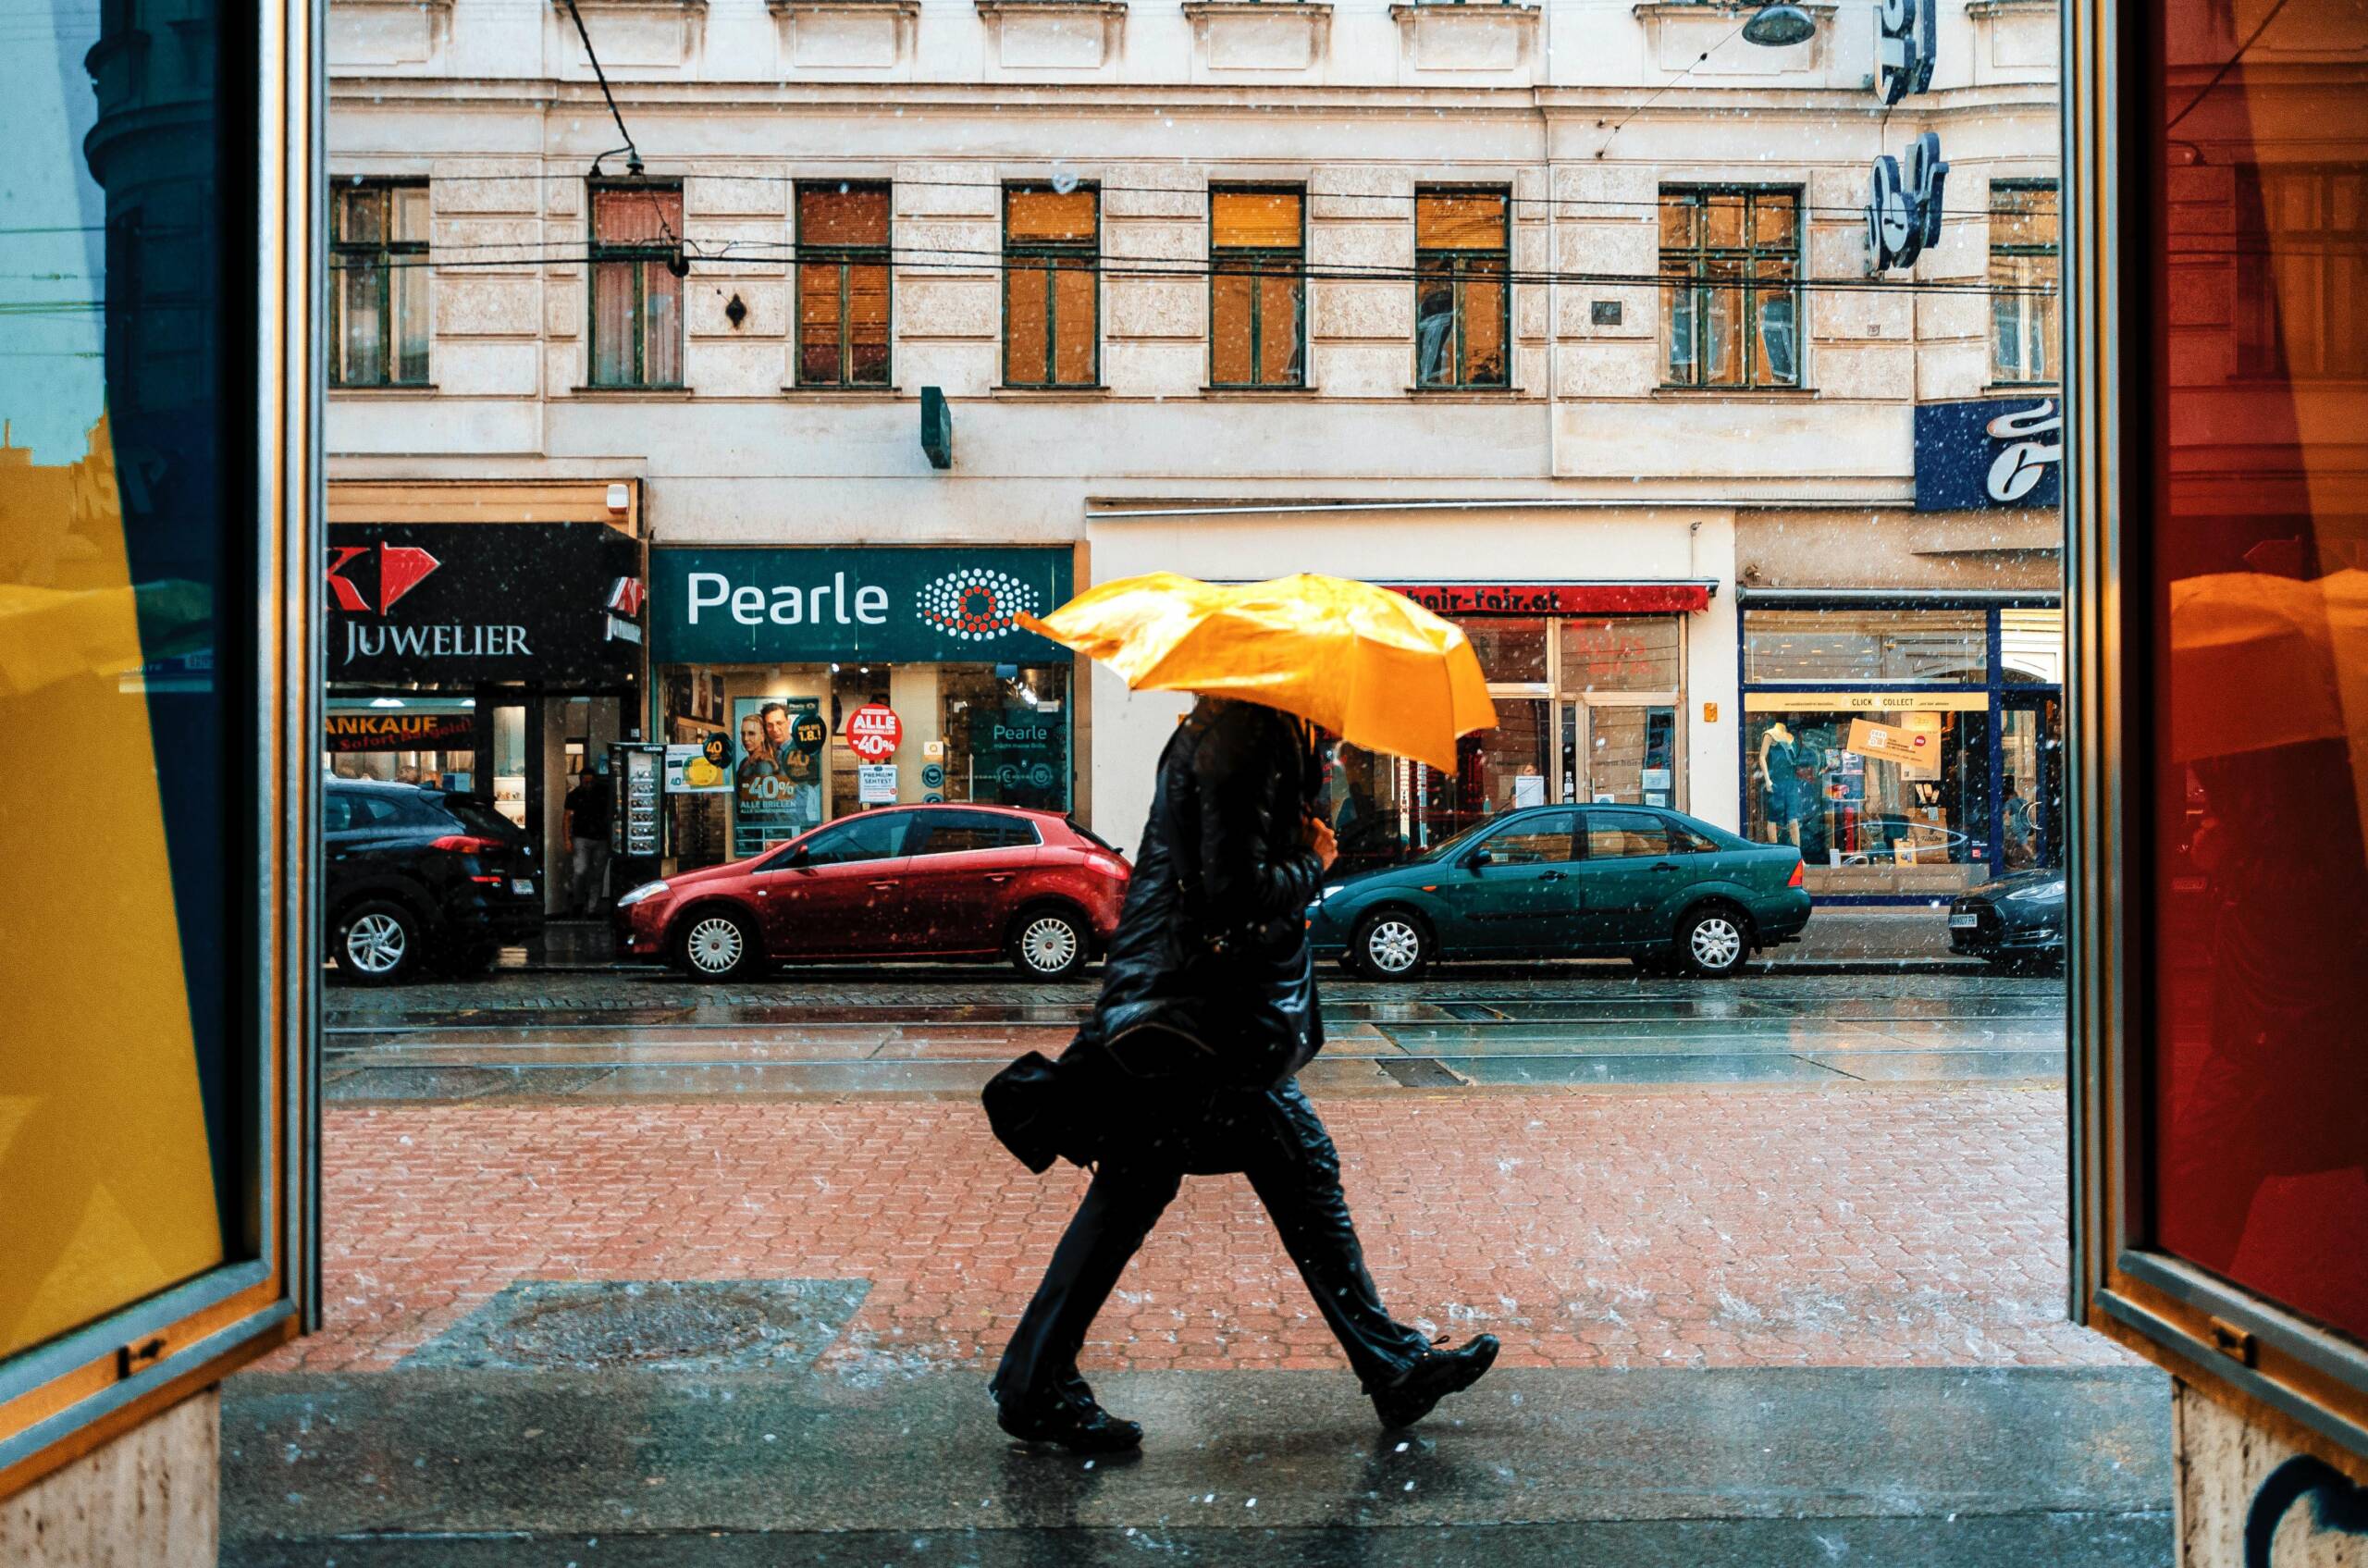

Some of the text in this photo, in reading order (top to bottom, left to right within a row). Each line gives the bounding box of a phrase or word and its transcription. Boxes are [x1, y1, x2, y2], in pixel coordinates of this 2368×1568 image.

[688, 572, 889, 625] Pearle
[1407, 587, 1560, 610] hair-fair.at
[343, 621, 534, 666] JUWELIER
[853, 715, 895, 729] ALLE
[993, 725, 1047, 739] Pearle
[339, 734, 396, 750] Sofort
[706, 741, 722, 754] 40
[853, 735, 895, 754] -40%
[742, 776, 794, 798] -40%
